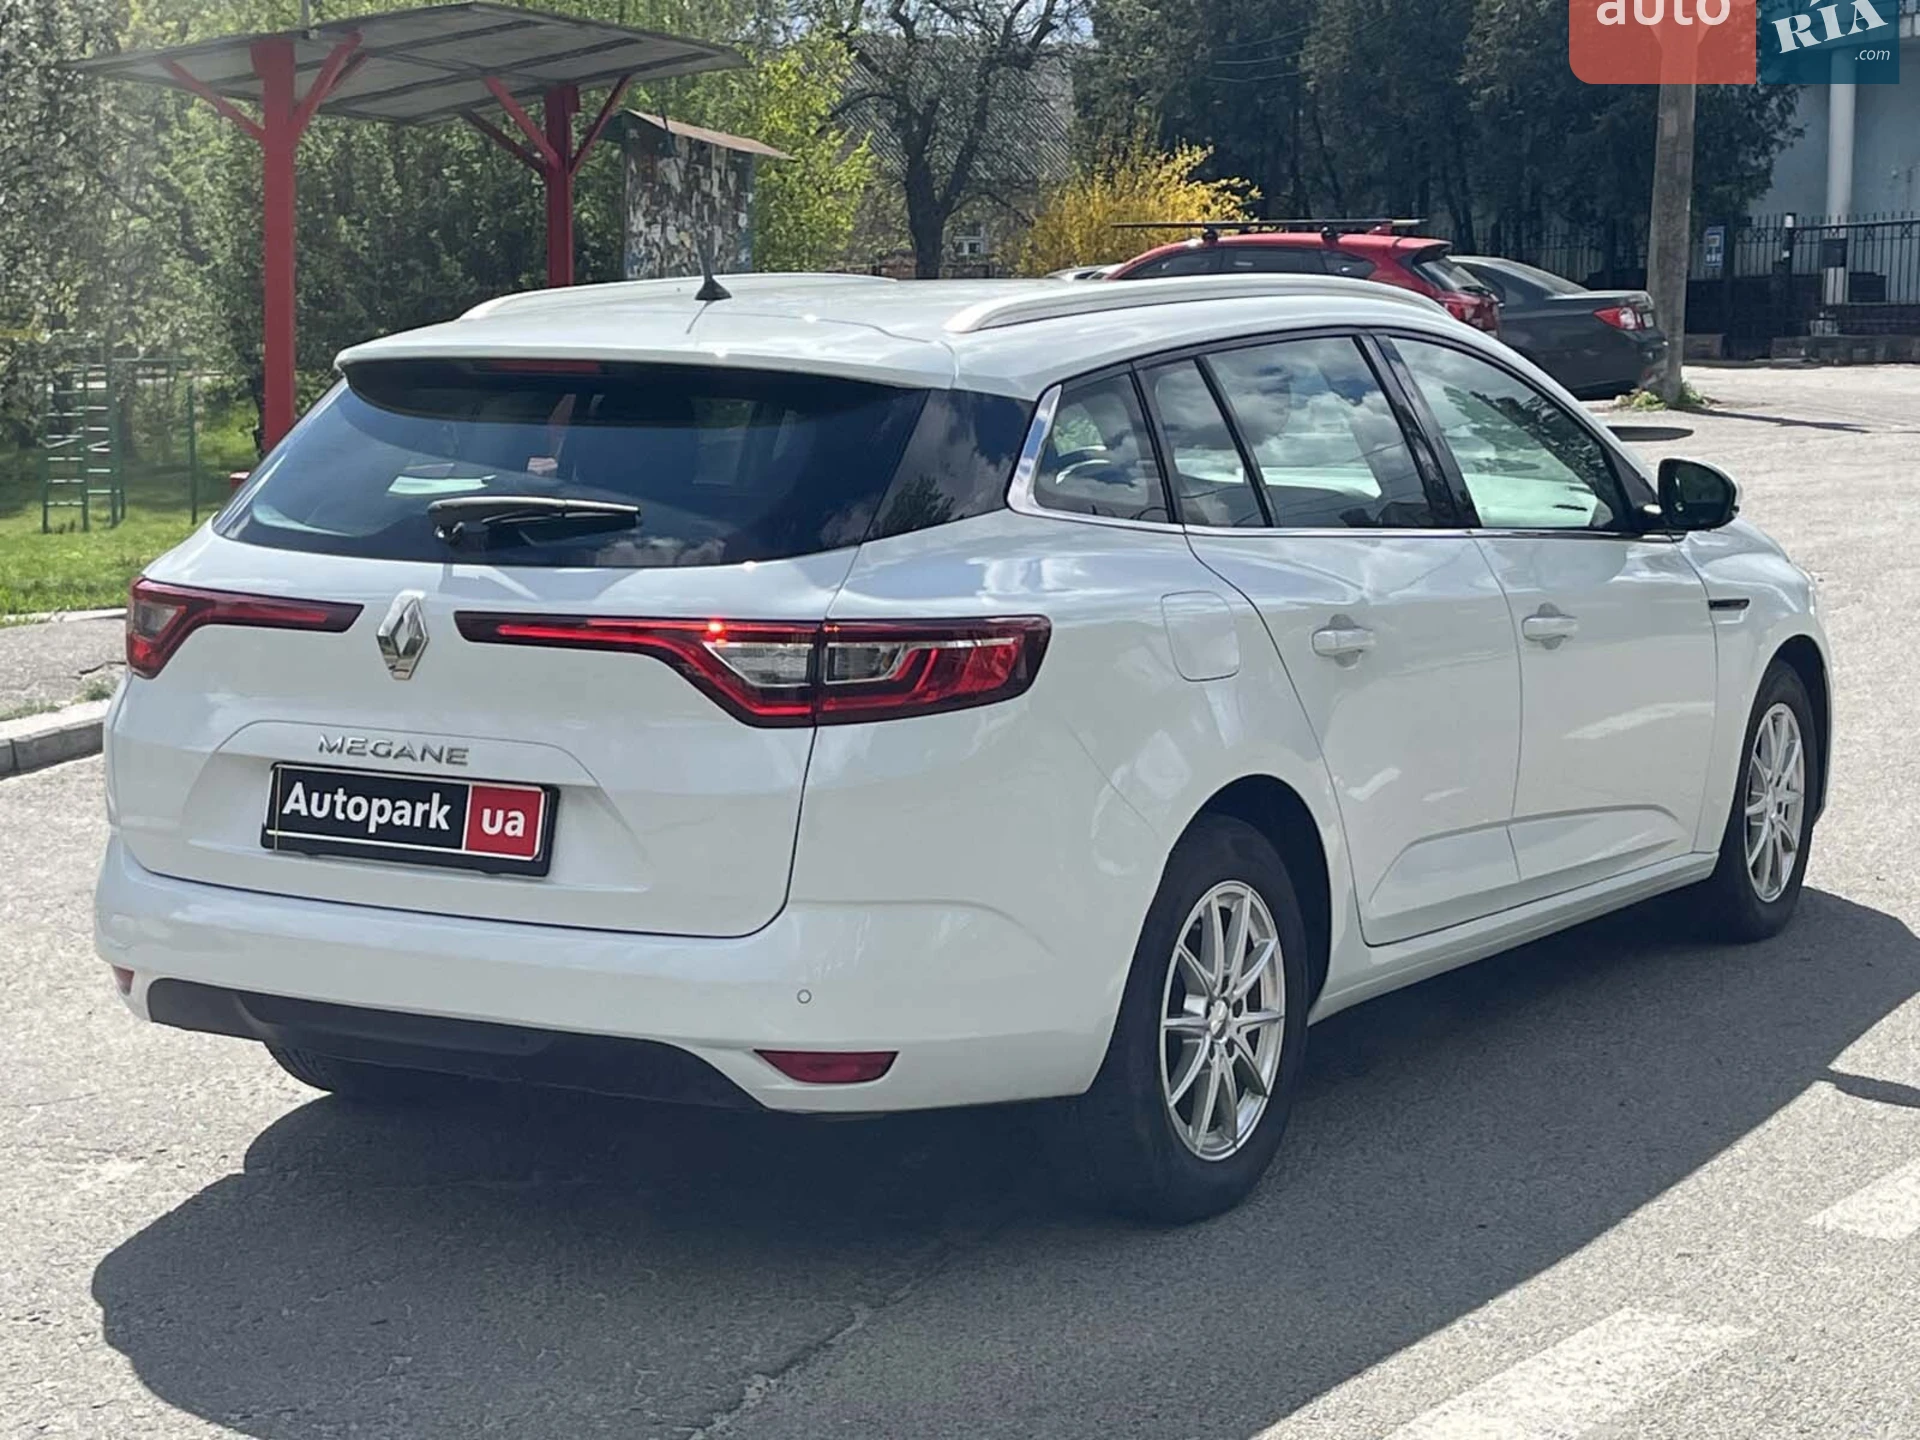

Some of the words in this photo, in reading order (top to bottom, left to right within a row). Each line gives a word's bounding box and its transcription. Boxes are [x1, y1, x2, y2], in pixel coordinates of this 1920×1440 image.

[317, 734, 469, 766] MEGANE
[282, 781, 451, 834] Autopark
[480, 807, 526, 838] ua
